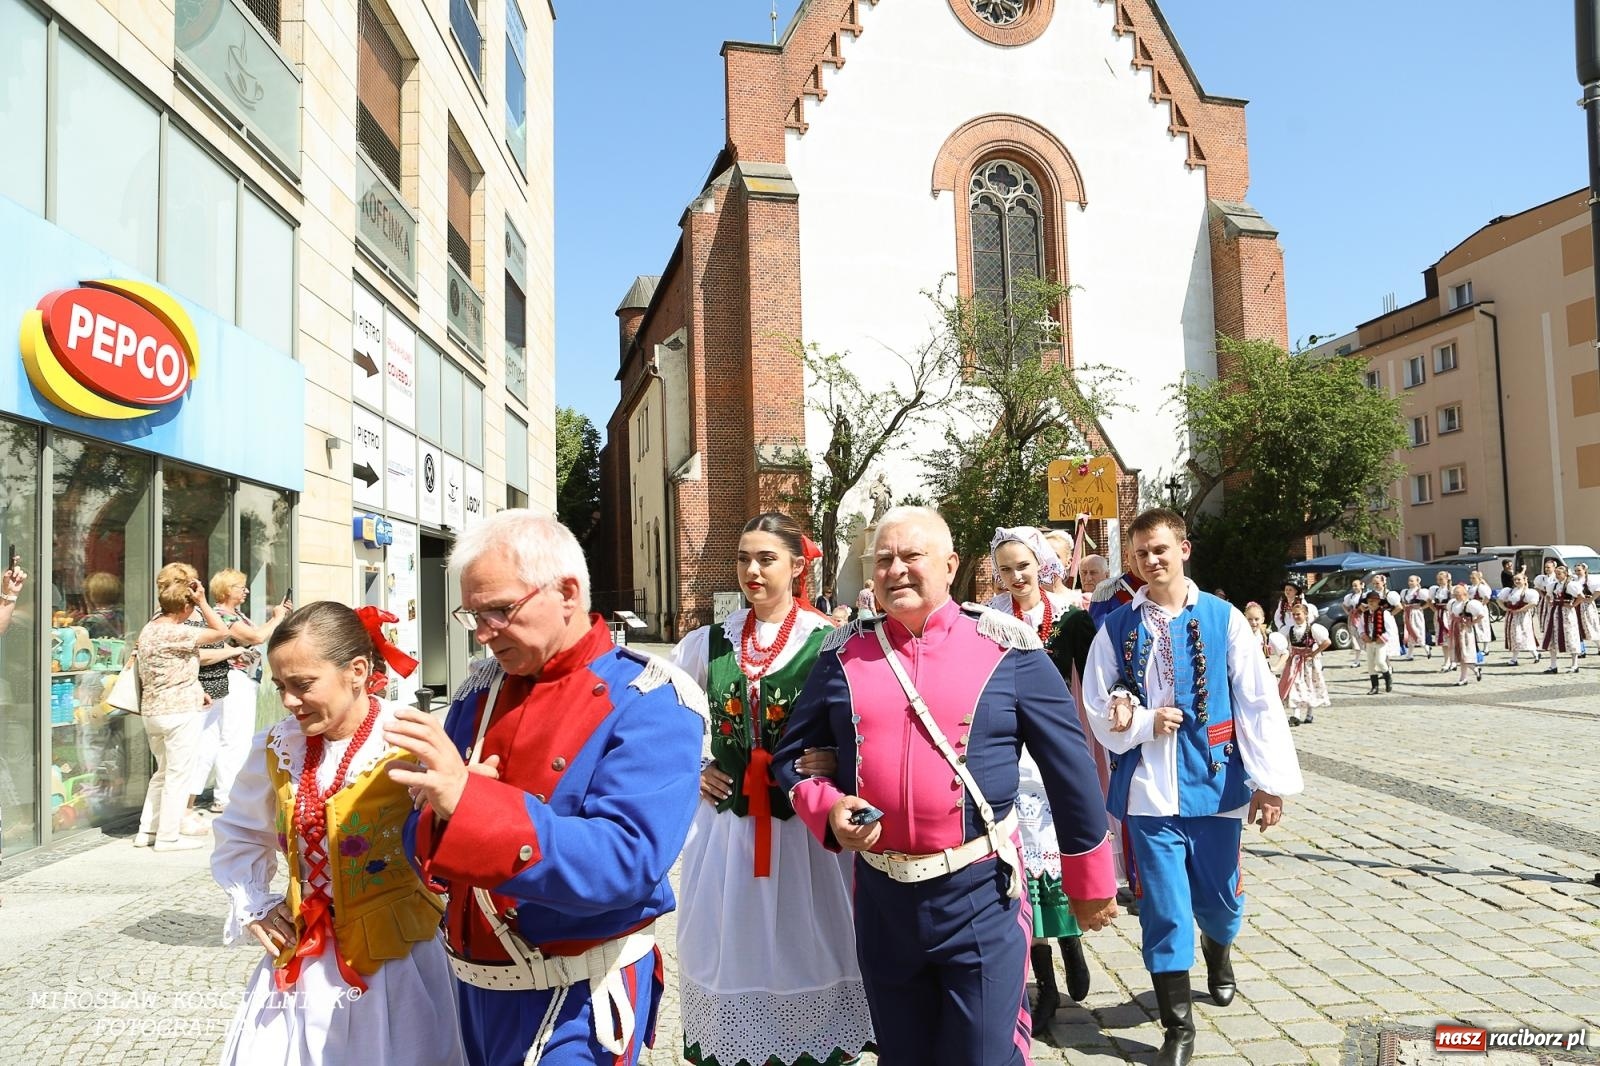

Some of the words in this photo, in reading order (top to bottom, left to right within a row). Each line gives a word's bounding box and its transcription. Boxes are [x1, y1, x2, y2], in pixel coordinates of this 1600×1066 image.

[361, 185, 410, 261] KOFEINKA
[67, 303, 180, 387] PEPCO
[359, 314, 381, 344] PIĘTRO
[358, 426, 380, 449] PIĘTRO
